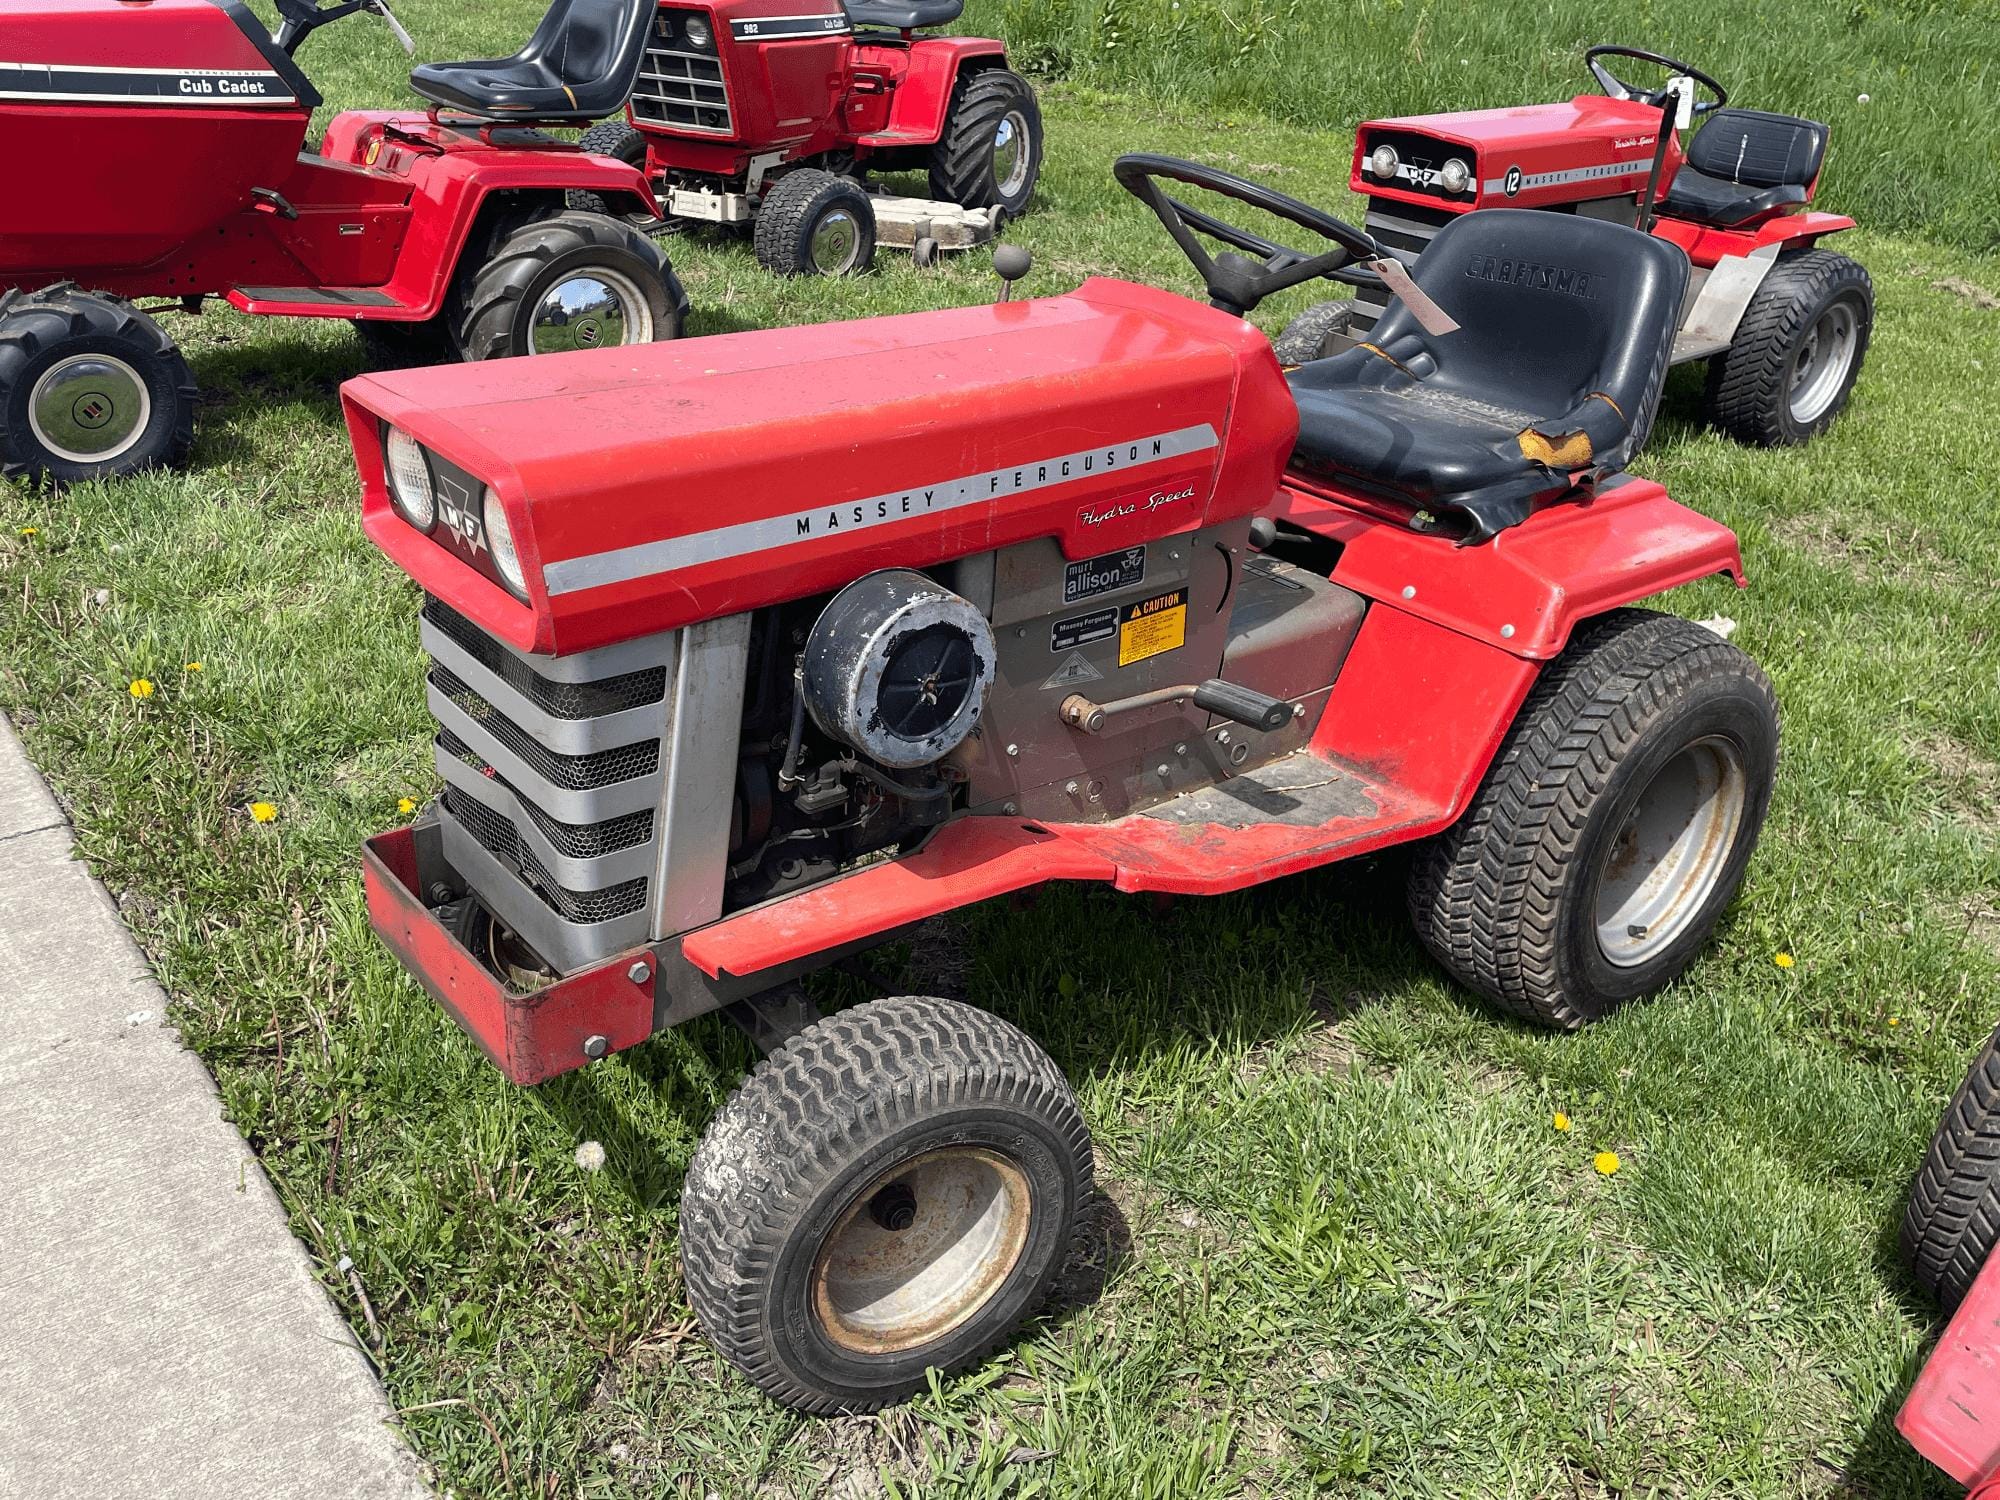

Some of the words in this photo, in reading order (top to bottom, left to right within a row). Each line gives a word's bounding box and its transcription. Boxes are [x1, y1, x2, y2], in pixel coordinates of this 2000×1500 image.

[743, 23, 759, 34] 982
[179, 78, 213, 93] Cub
[218, 79, 266, 94] Cadet
[1506, 172, 1519, 192] 12
[1526, 173, 1569, 185] MASSEY
[1585, 163, 1639, 177] FERGUSON
[796, 490, 934, 536] MASSEY
[990, 440, 1163, 492] FERGUSON
[1080, 503, 1137, 528] Hydra
[1141, 483, 1196, 513] Speed
[1067, 568, 1120, 595] allison
[1143, 592, 1180, 614] CAUTION
[1059, 621, 1084, 632] Massey
[1084, 613, 1112, 625] Ferguson
